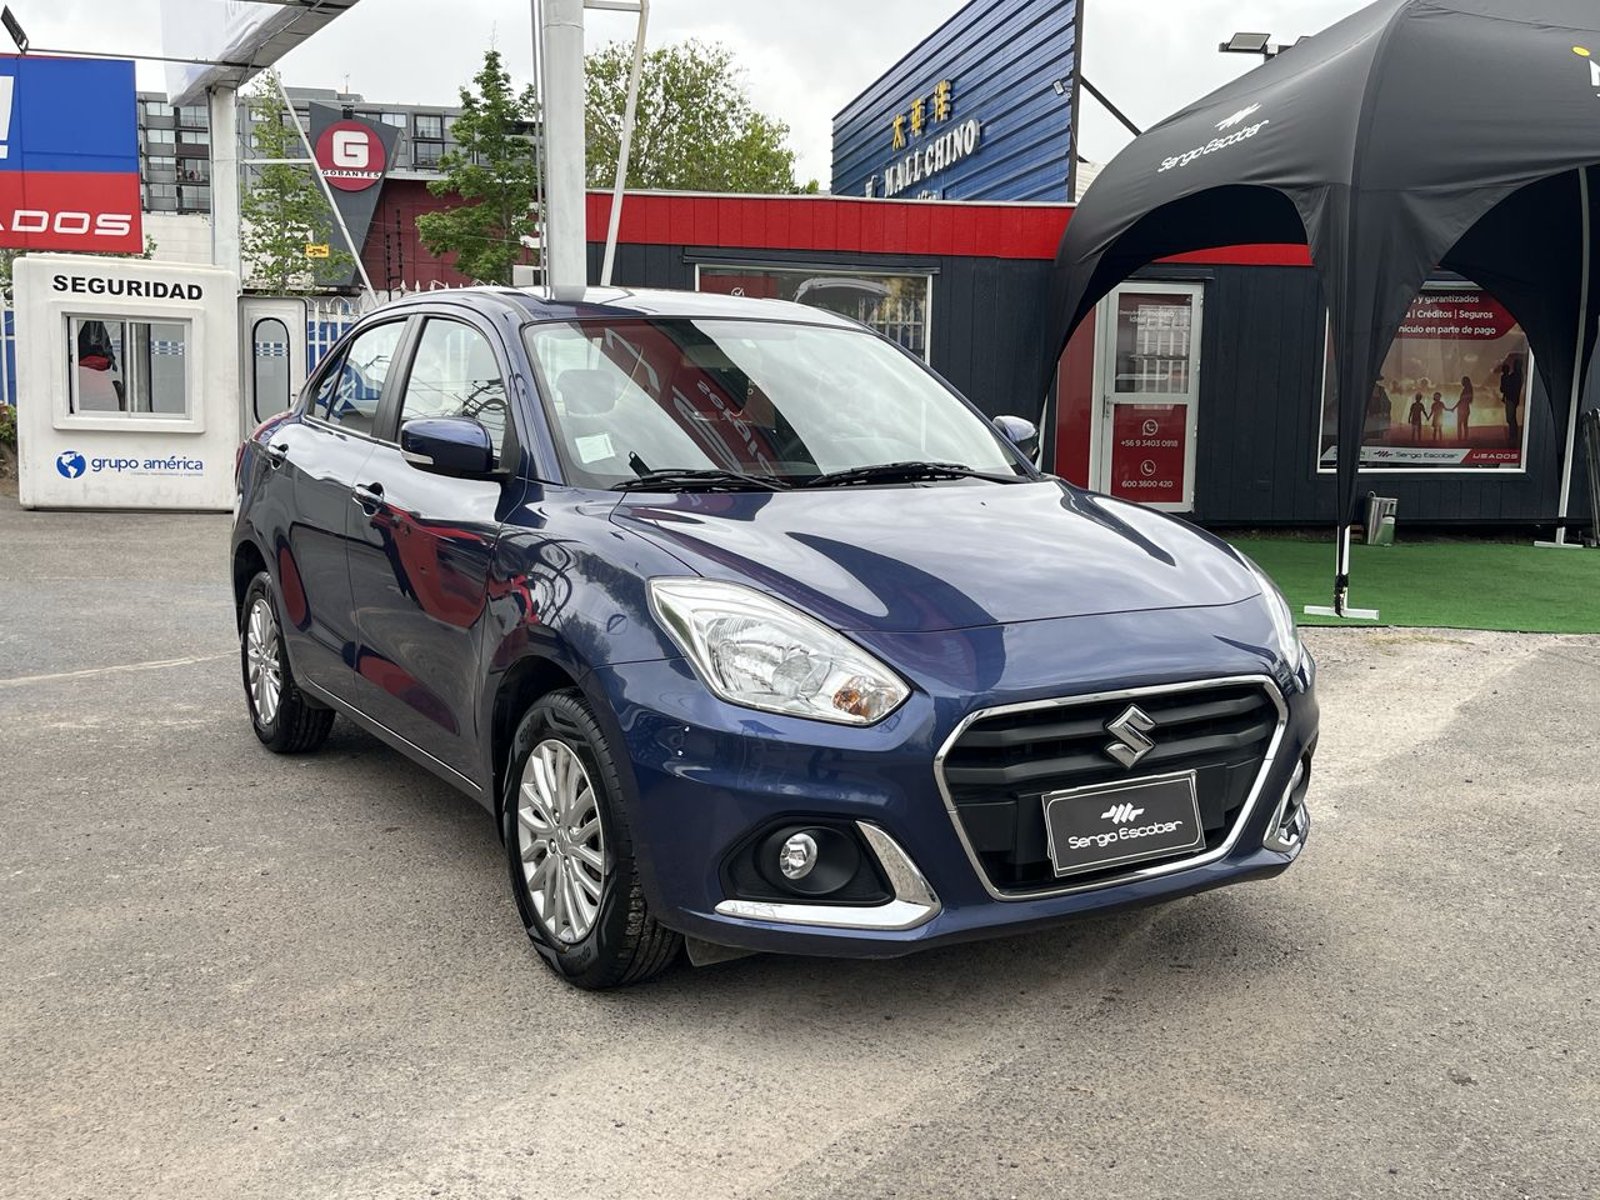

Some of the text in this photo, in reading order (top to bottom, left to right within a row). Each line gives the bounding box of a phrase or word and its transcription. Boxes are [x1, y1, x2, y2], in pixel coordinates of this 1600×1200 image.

[332, 130, 369, 168] G
[884, 148, 923, 197] MALL
[924, 119, 980, 176] CHINO
[322, 169, 380, 178] GOBANTES
[0, 209, 133, 236] DOS
[52, 274, 204, 300] SEGURIDAD
[1424, 294, 1479, 304] garantizados
[1417, 309, 1452, 319] Créditos
[1459, 310, 1494, 320] Seguros
[1437, 326, 1460, 335] parte
[1474, 327, 1496, 335] pago
[1120, 439, 1135, 447] +56
[1135, 439, 1141, 447] 9
[91, 456, 203, 472] grupo américa
[1121, 480, 1137, 488] 600
[1158, 480, 1173, 488] 420
[1118, 820, 1183, 840] Escobar
